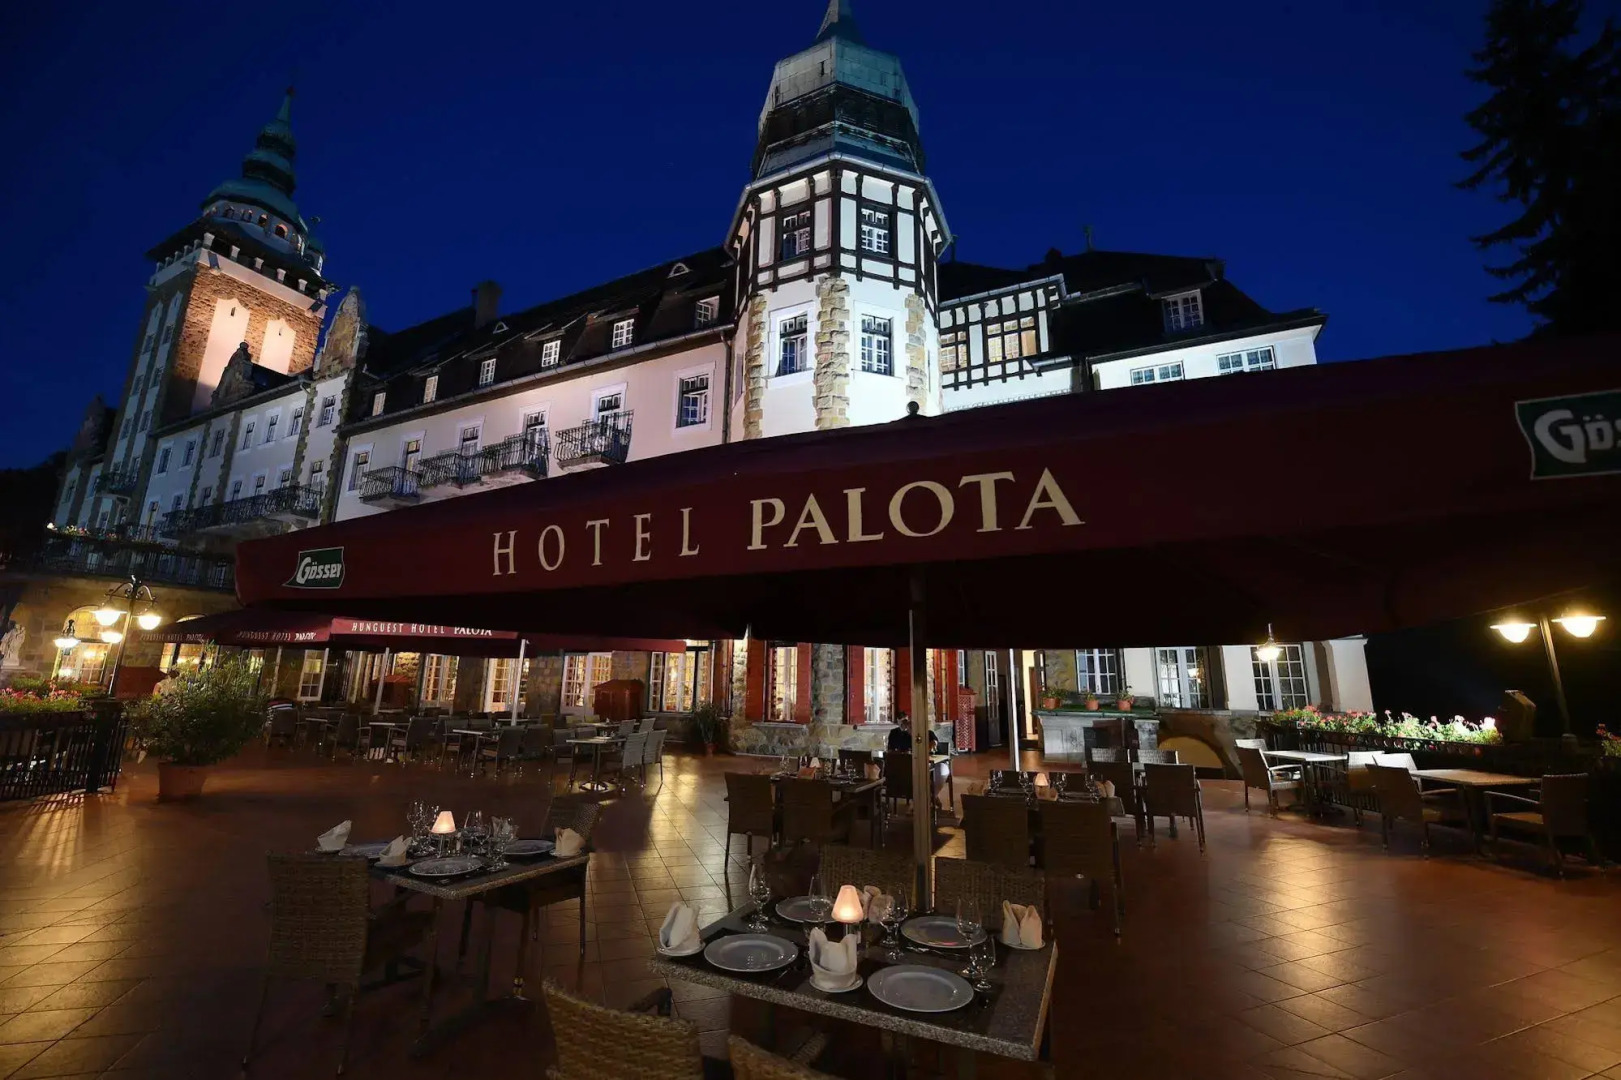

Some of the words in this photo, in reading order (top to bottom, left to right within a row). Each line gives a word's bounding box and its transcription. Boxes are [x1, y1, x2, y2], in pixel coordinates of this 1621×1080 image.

[1534, 408, 1621, 463] Gö
[492, 507, 700, 576] HOTEL
[747, 467, 1085, 550] PALOTA
[296, 556, 342, 584] Gösser
[351, 622, 403, 633] HUNGUEST
[411, 623, 445, 634] HOTEL
